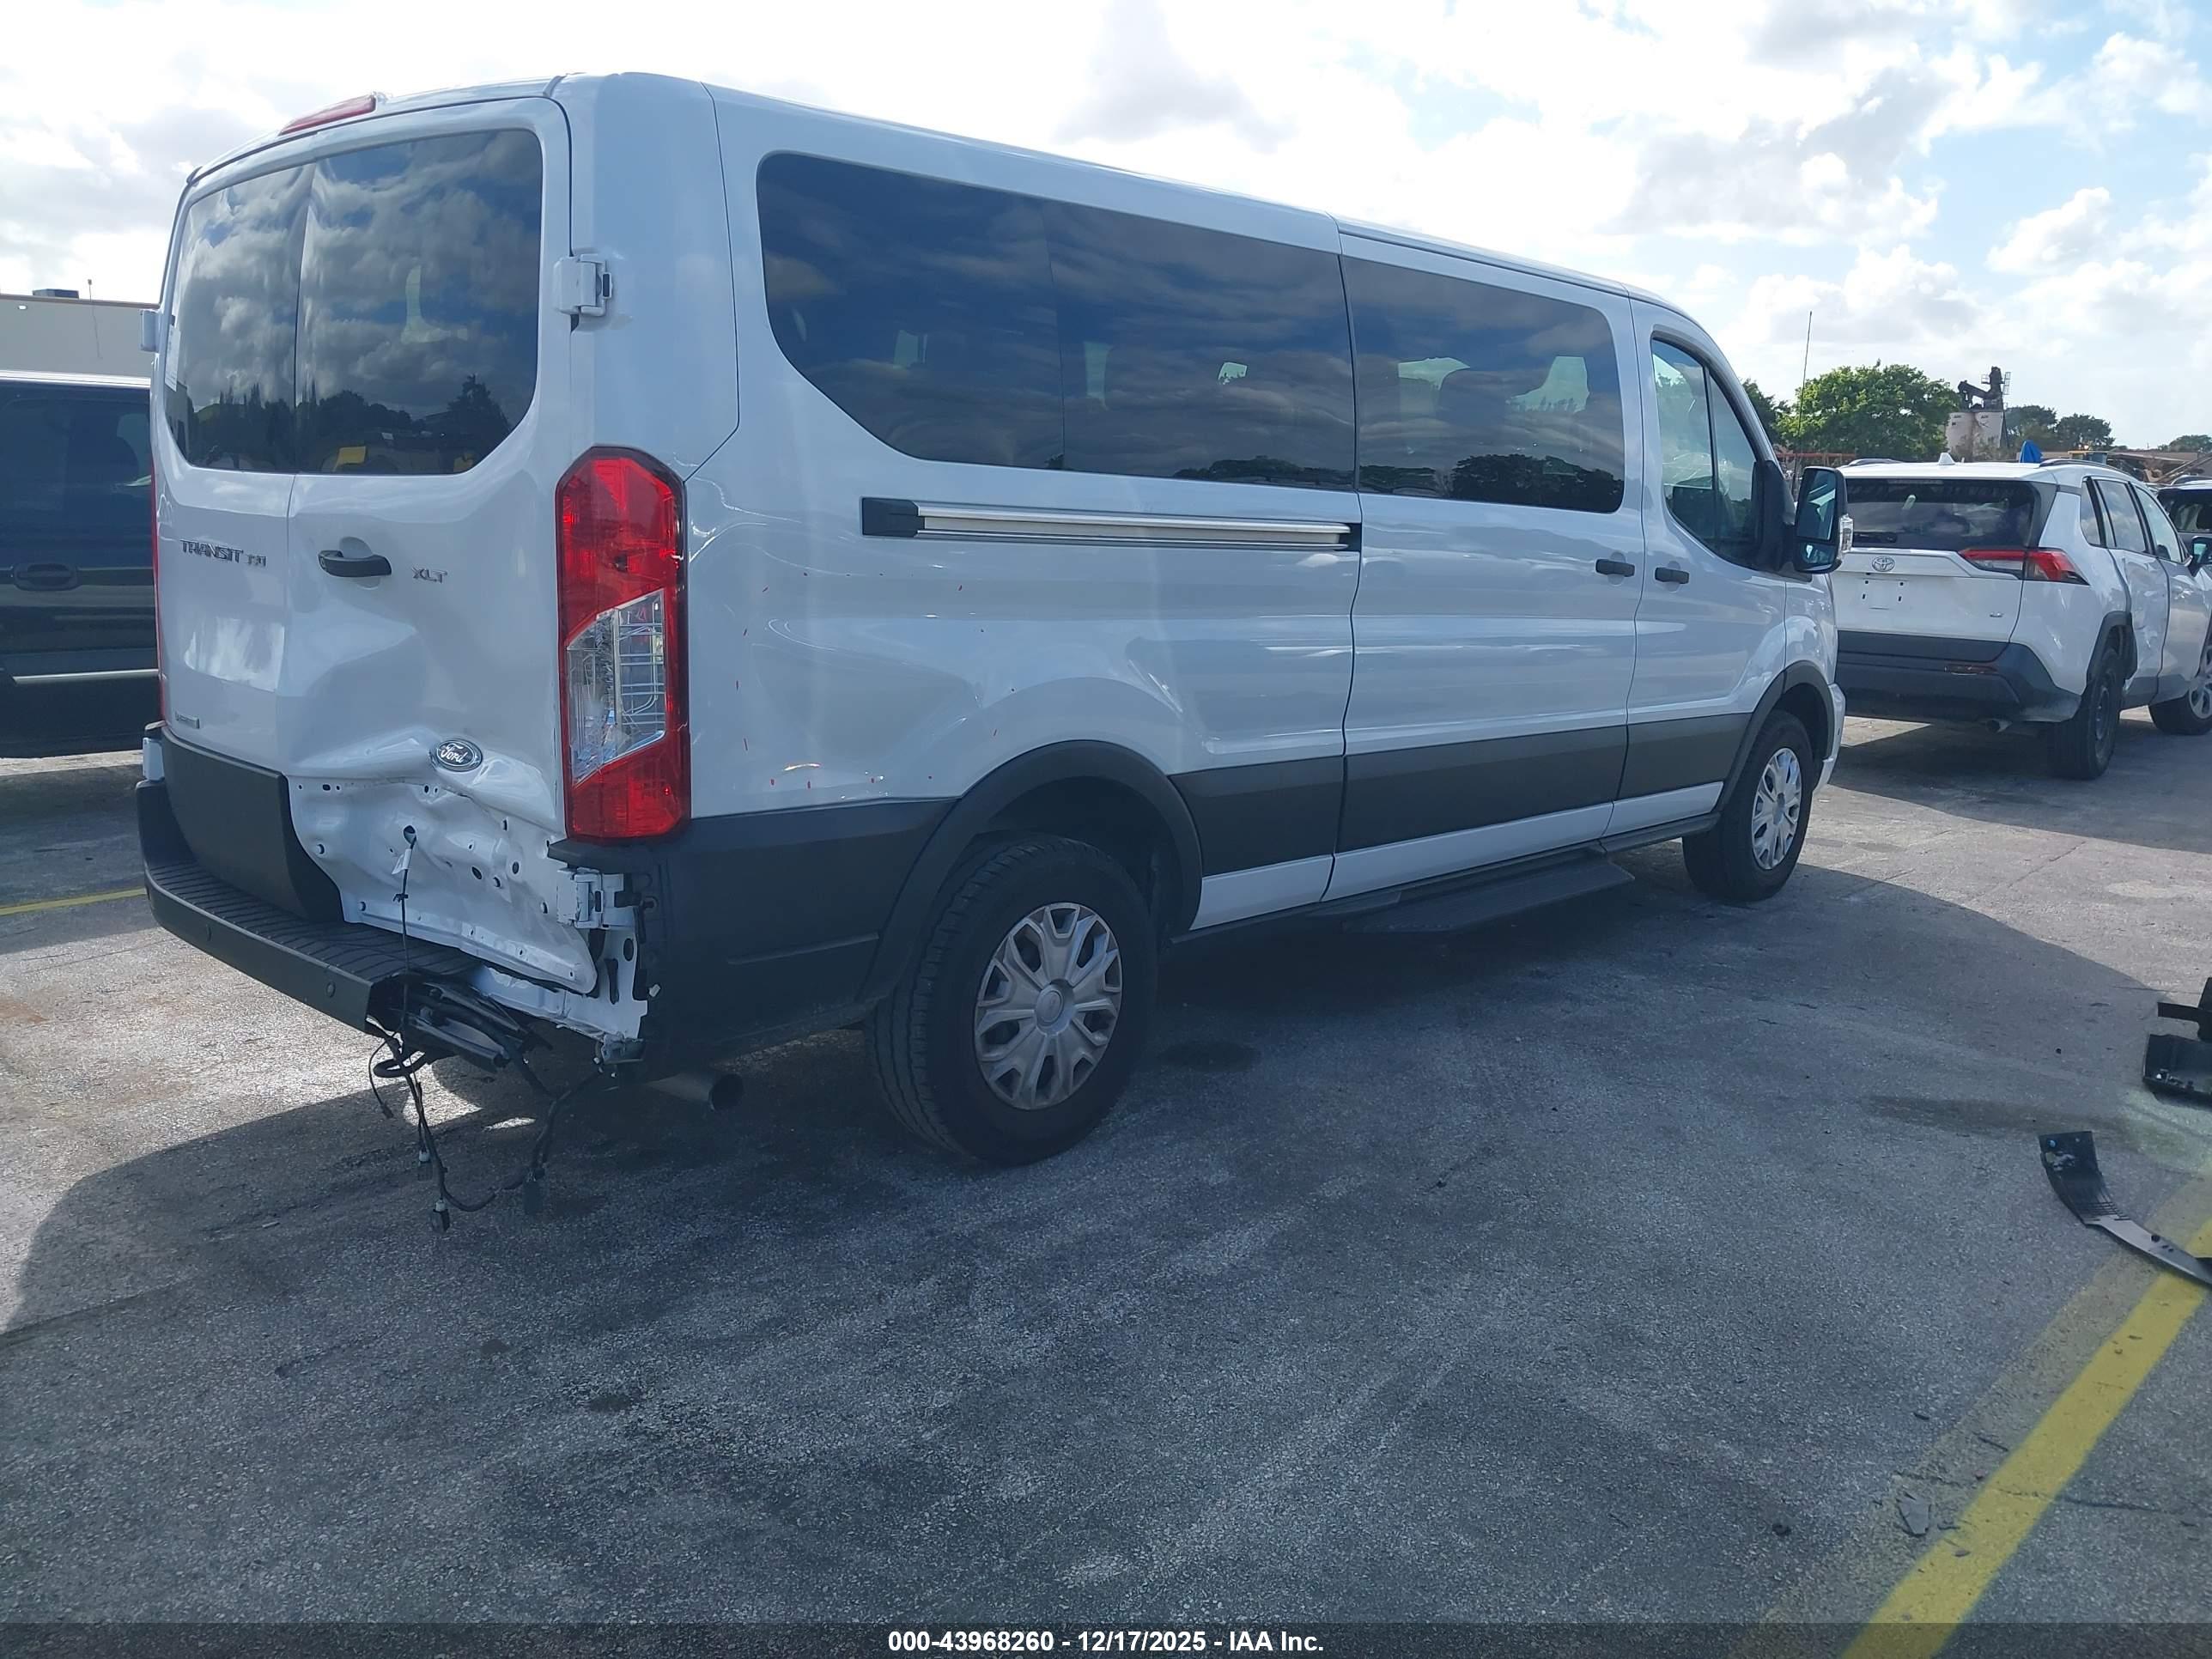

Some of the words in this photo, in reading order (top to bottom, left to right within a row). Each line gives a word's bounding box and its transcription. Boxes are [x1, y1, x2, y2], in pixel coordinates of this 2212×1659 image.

[179, 538, 244, 563] TRANSIT
[411, 566, 447, 584] XLT
[440, 742, 468, 763] Ford
